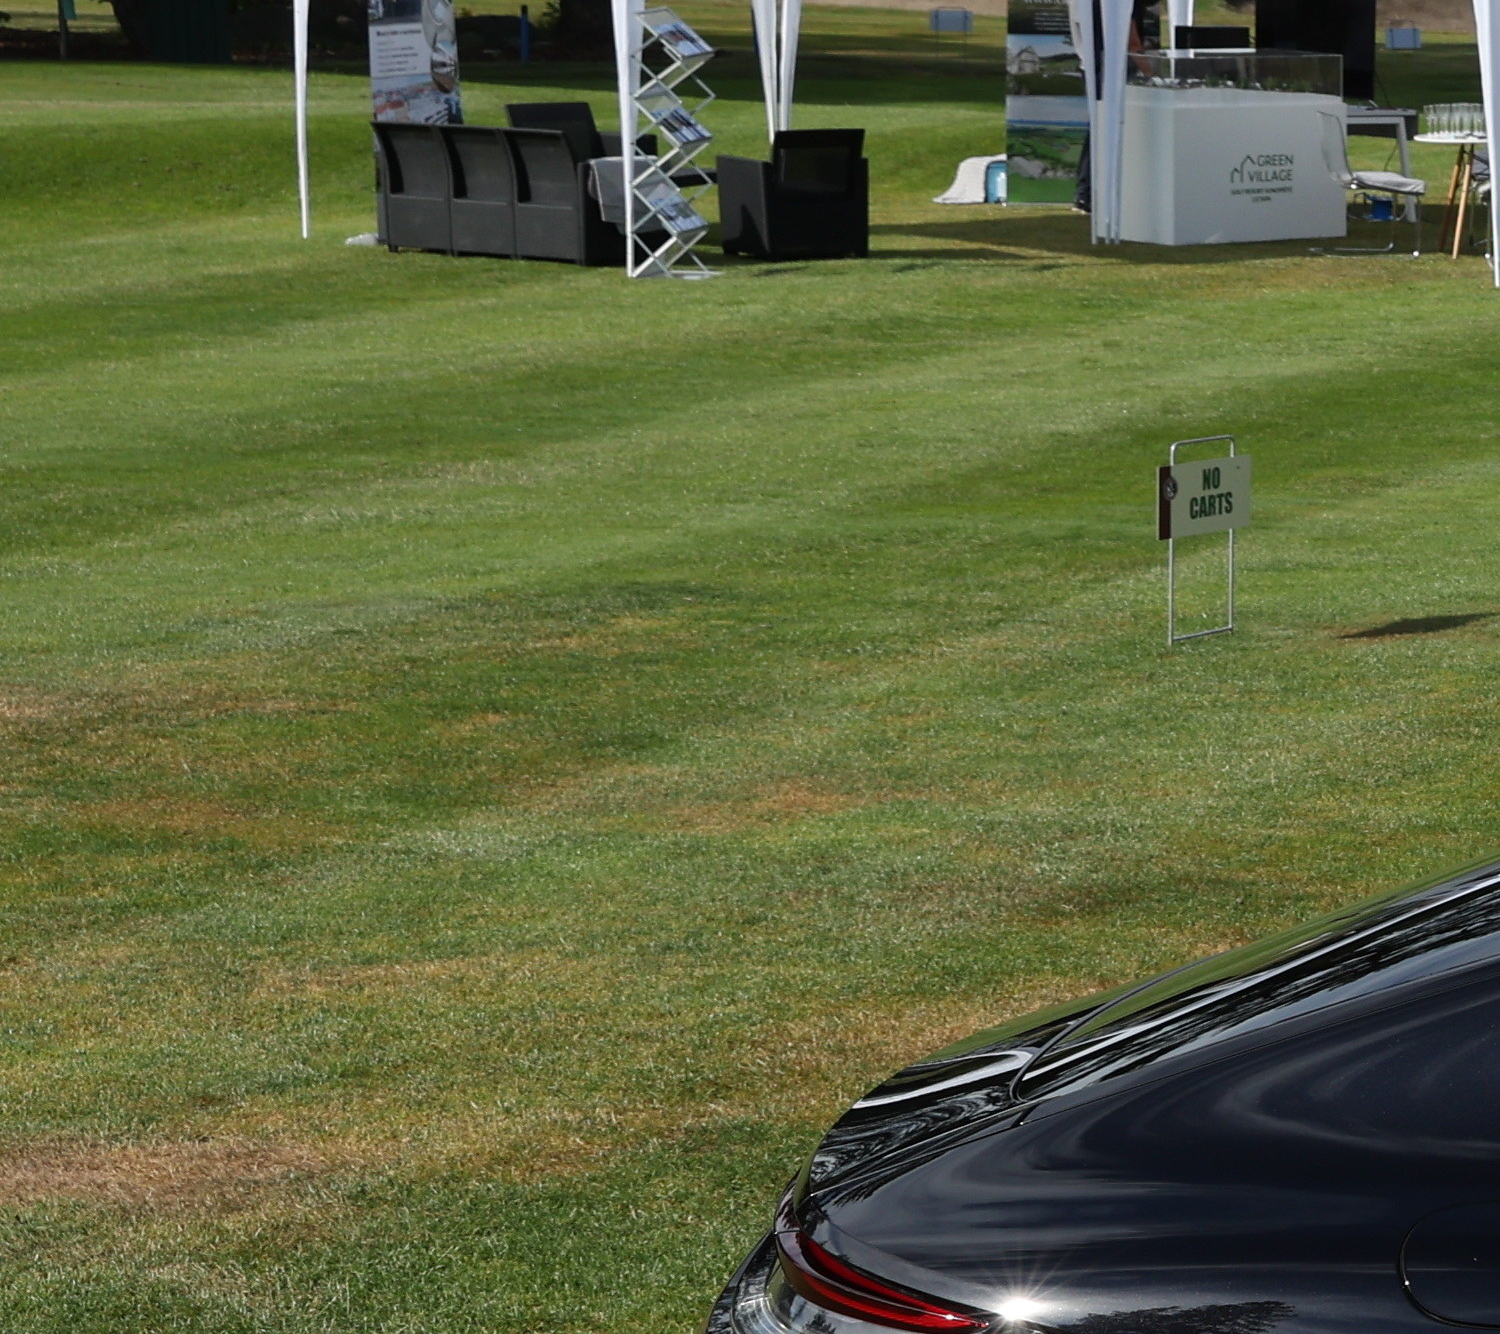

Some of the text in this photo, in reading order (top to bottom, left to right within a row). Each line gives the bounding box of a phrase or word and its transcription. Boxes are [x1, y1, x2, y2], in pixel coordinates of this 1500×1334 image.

[1257, 155, 1294, 167] GREEN
[1248, 169, 1293, 182] VILLAGE
[1202, 467, 1221, 491] NO
[1189, 491, 1233, 520] CARTS
